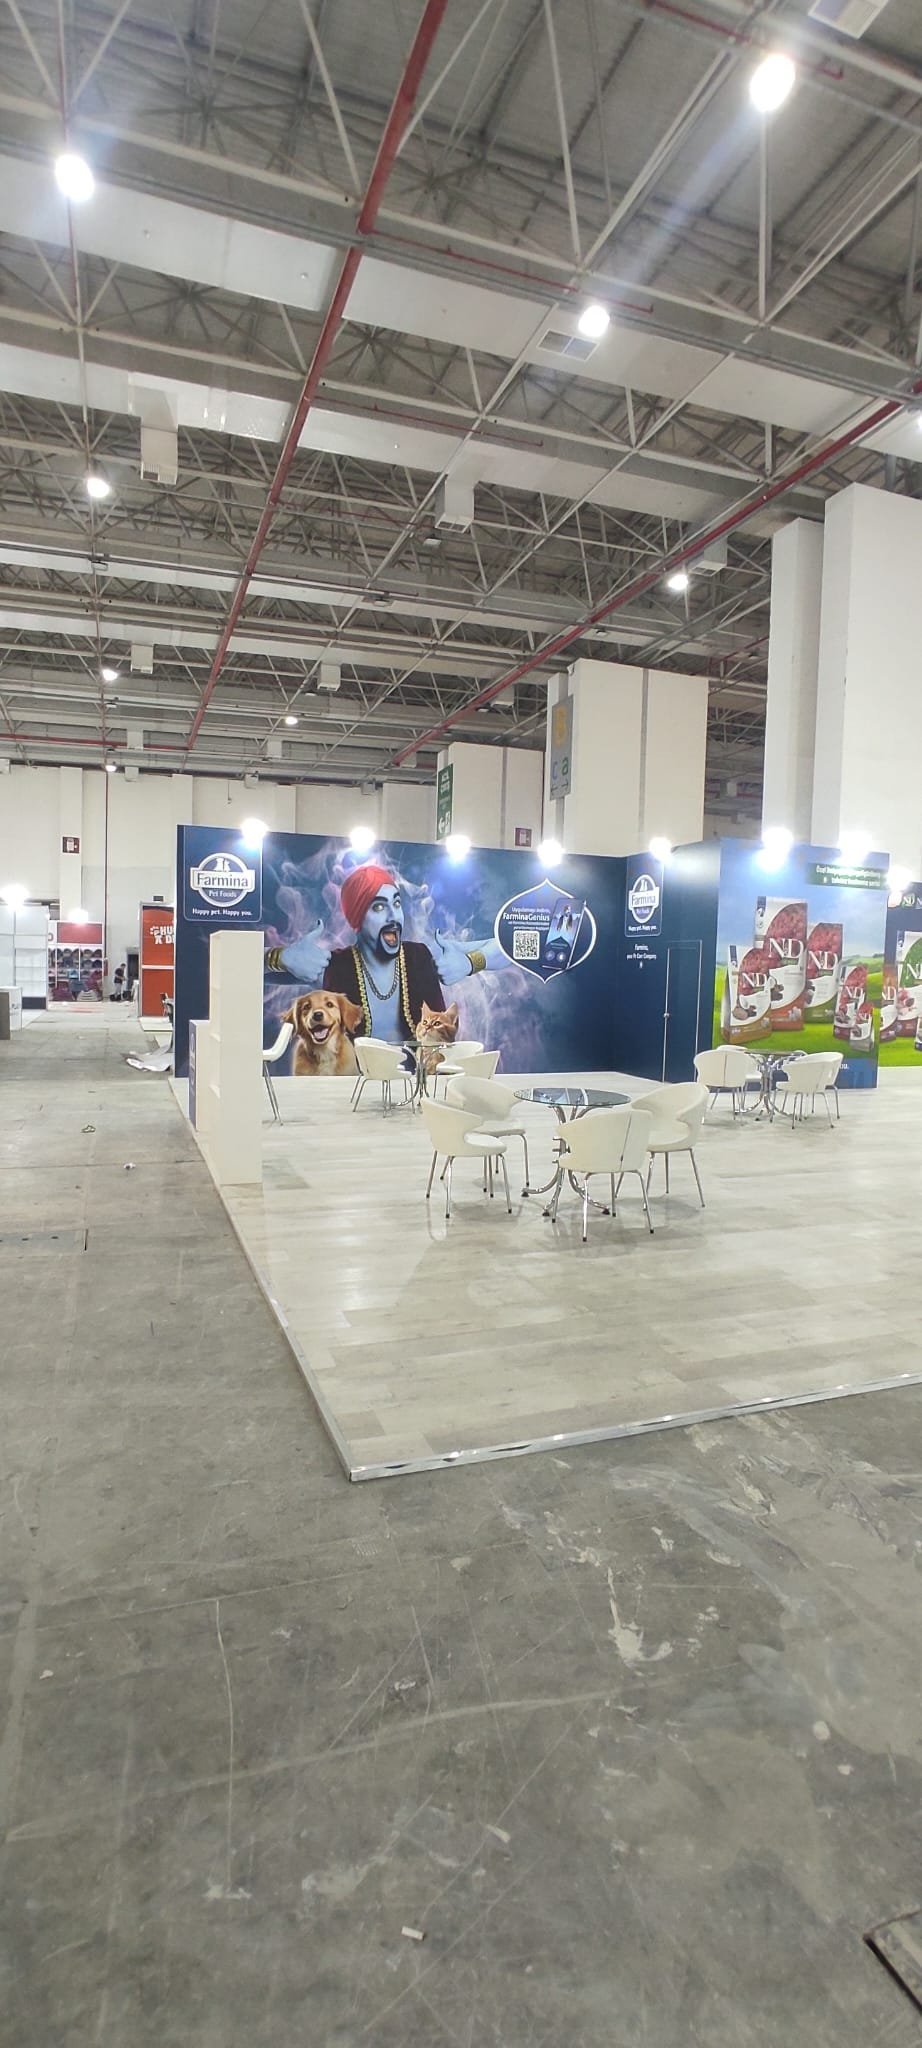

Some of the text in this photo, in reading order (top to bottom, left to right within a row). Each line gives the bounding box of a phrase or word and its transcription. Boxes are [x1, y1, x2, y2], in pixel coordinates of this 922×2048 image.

[197, 873, 248, 887] Farmina
[632, 893, 656, 906] Farmina
[503, 913, 550, 921] FarminaGenius
